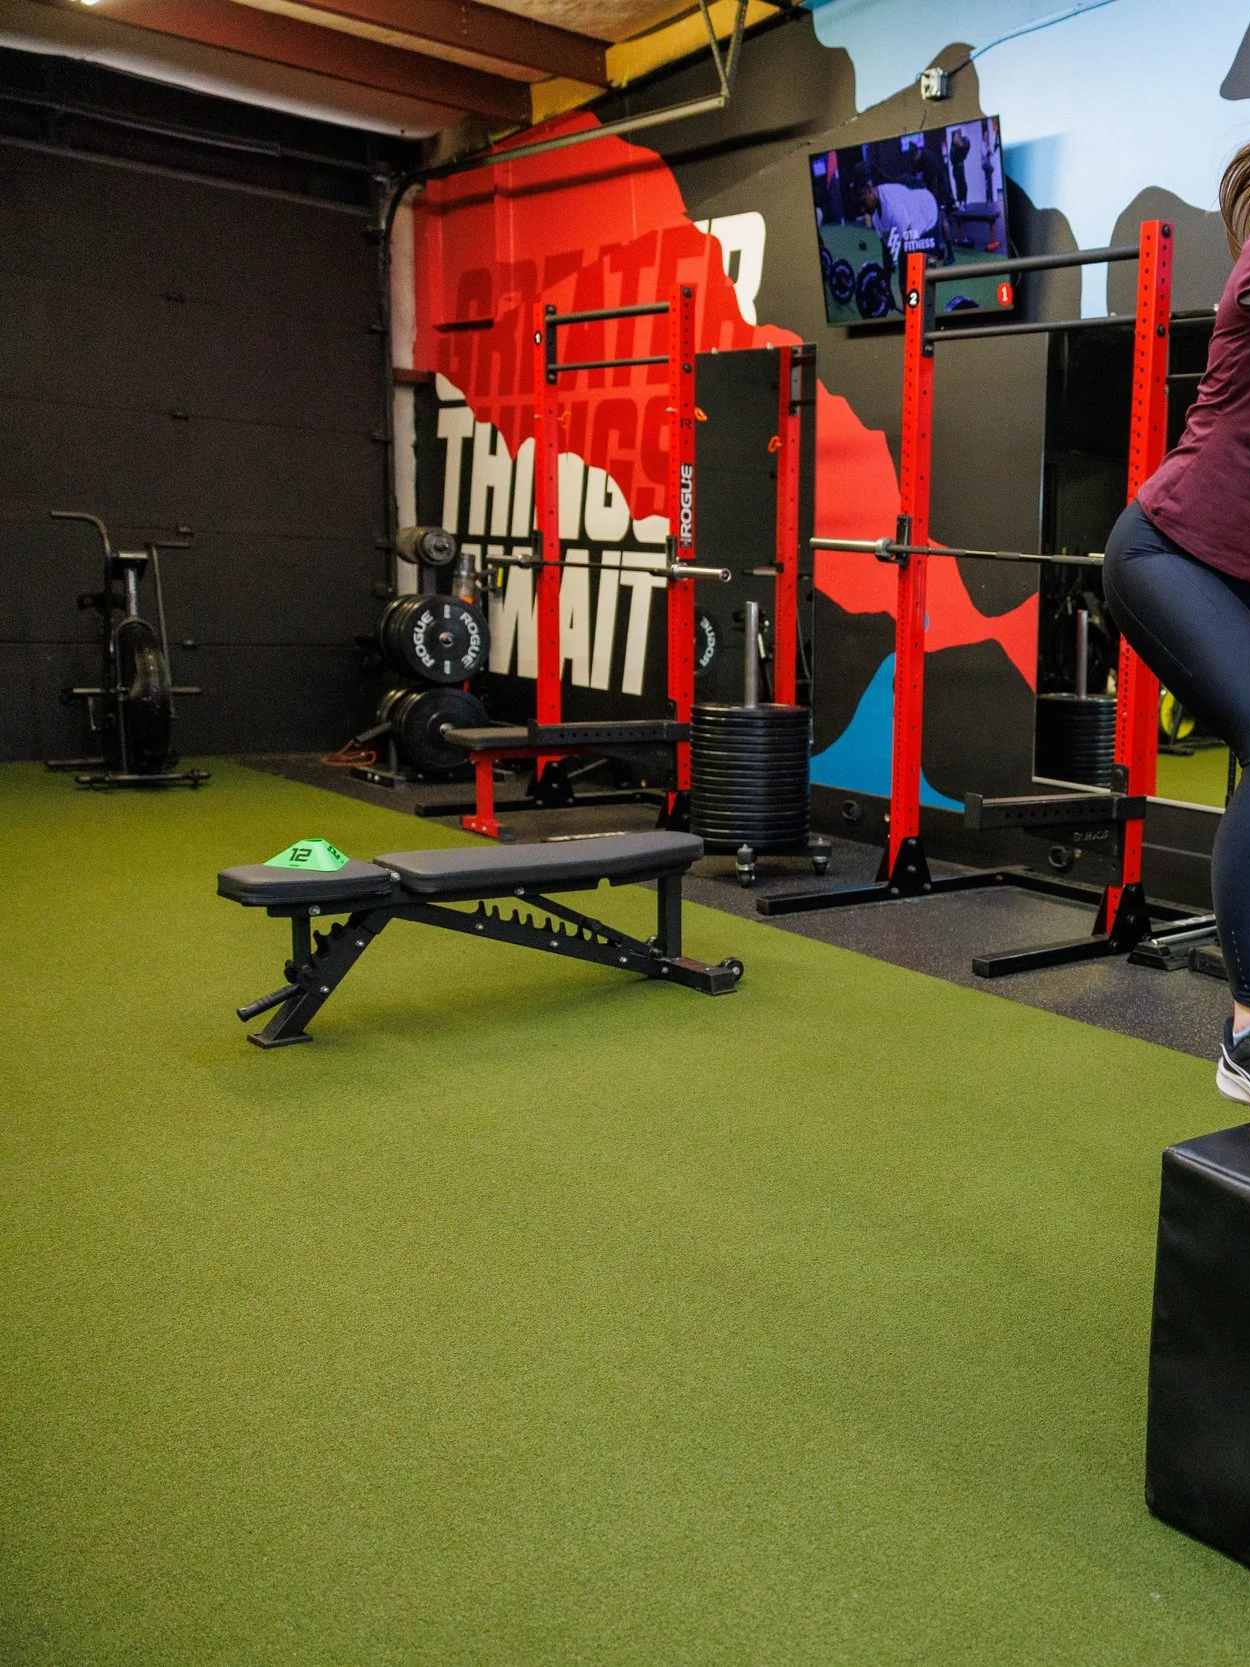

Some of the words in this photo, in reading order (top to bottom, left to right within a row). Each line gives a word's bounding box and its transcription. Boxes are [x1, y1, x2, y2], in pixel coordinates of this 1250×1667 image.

[904, 237, 935, 252] FITNESS
[909, 291, 918, 306] 2
[1001, 286, 1008, 302] 1
[681, 463, 692, 538] ROGUE
[413, 610, 435, 668] ROGUE
[460, 611, 480, 669] ROGUE
[289, 847, 312, 862] 12
